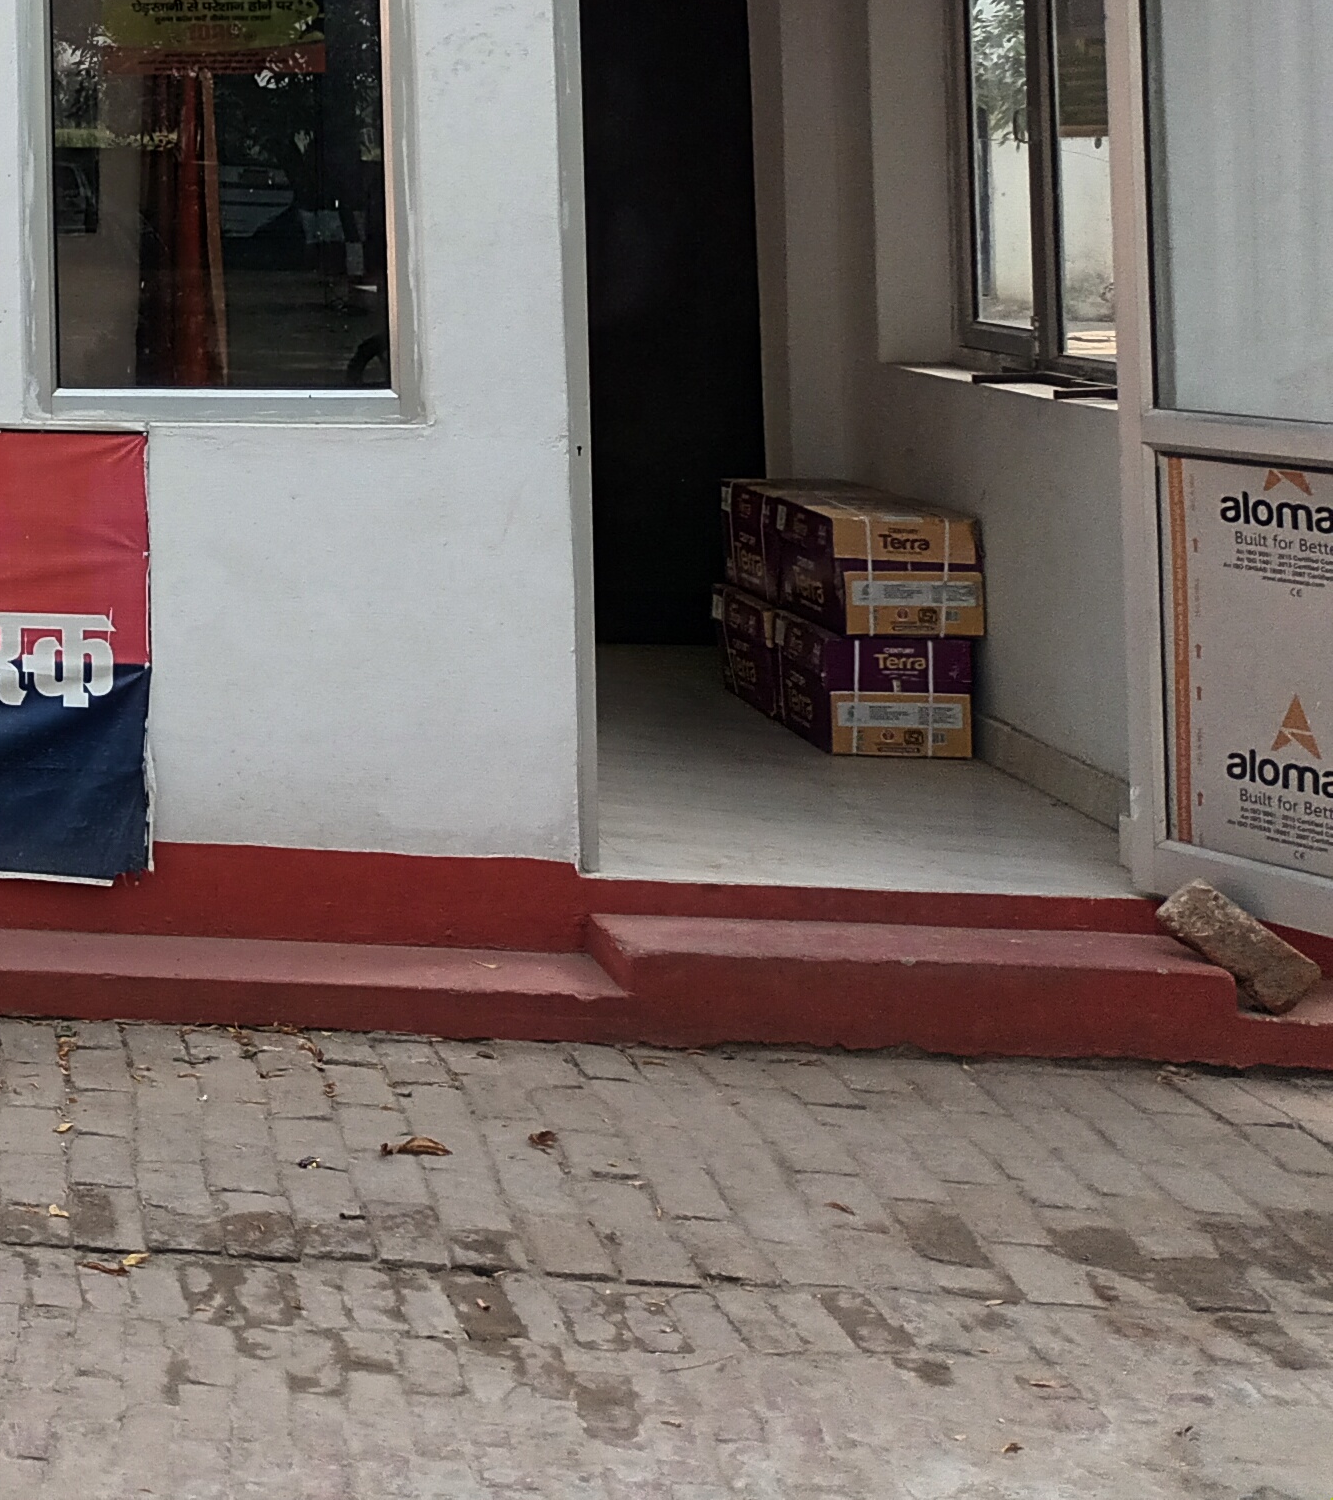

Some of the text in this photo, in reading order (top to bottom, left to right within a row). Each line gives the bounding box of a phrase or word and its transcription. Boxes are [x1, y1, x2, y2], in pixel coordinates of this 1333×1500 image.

[1220, 491, 1333, 534] aloma
[878, 534, 930, 551] Terra
[1235, 531, 1268, 548] Built
[1272, 534, 1294, 550] for
[873, 653, 926, 670] Terra
[1226, 749, 1333, 799] aloma
[1239, 788, 1273, 807] Built
[1278, 795, 1299, 812] for
